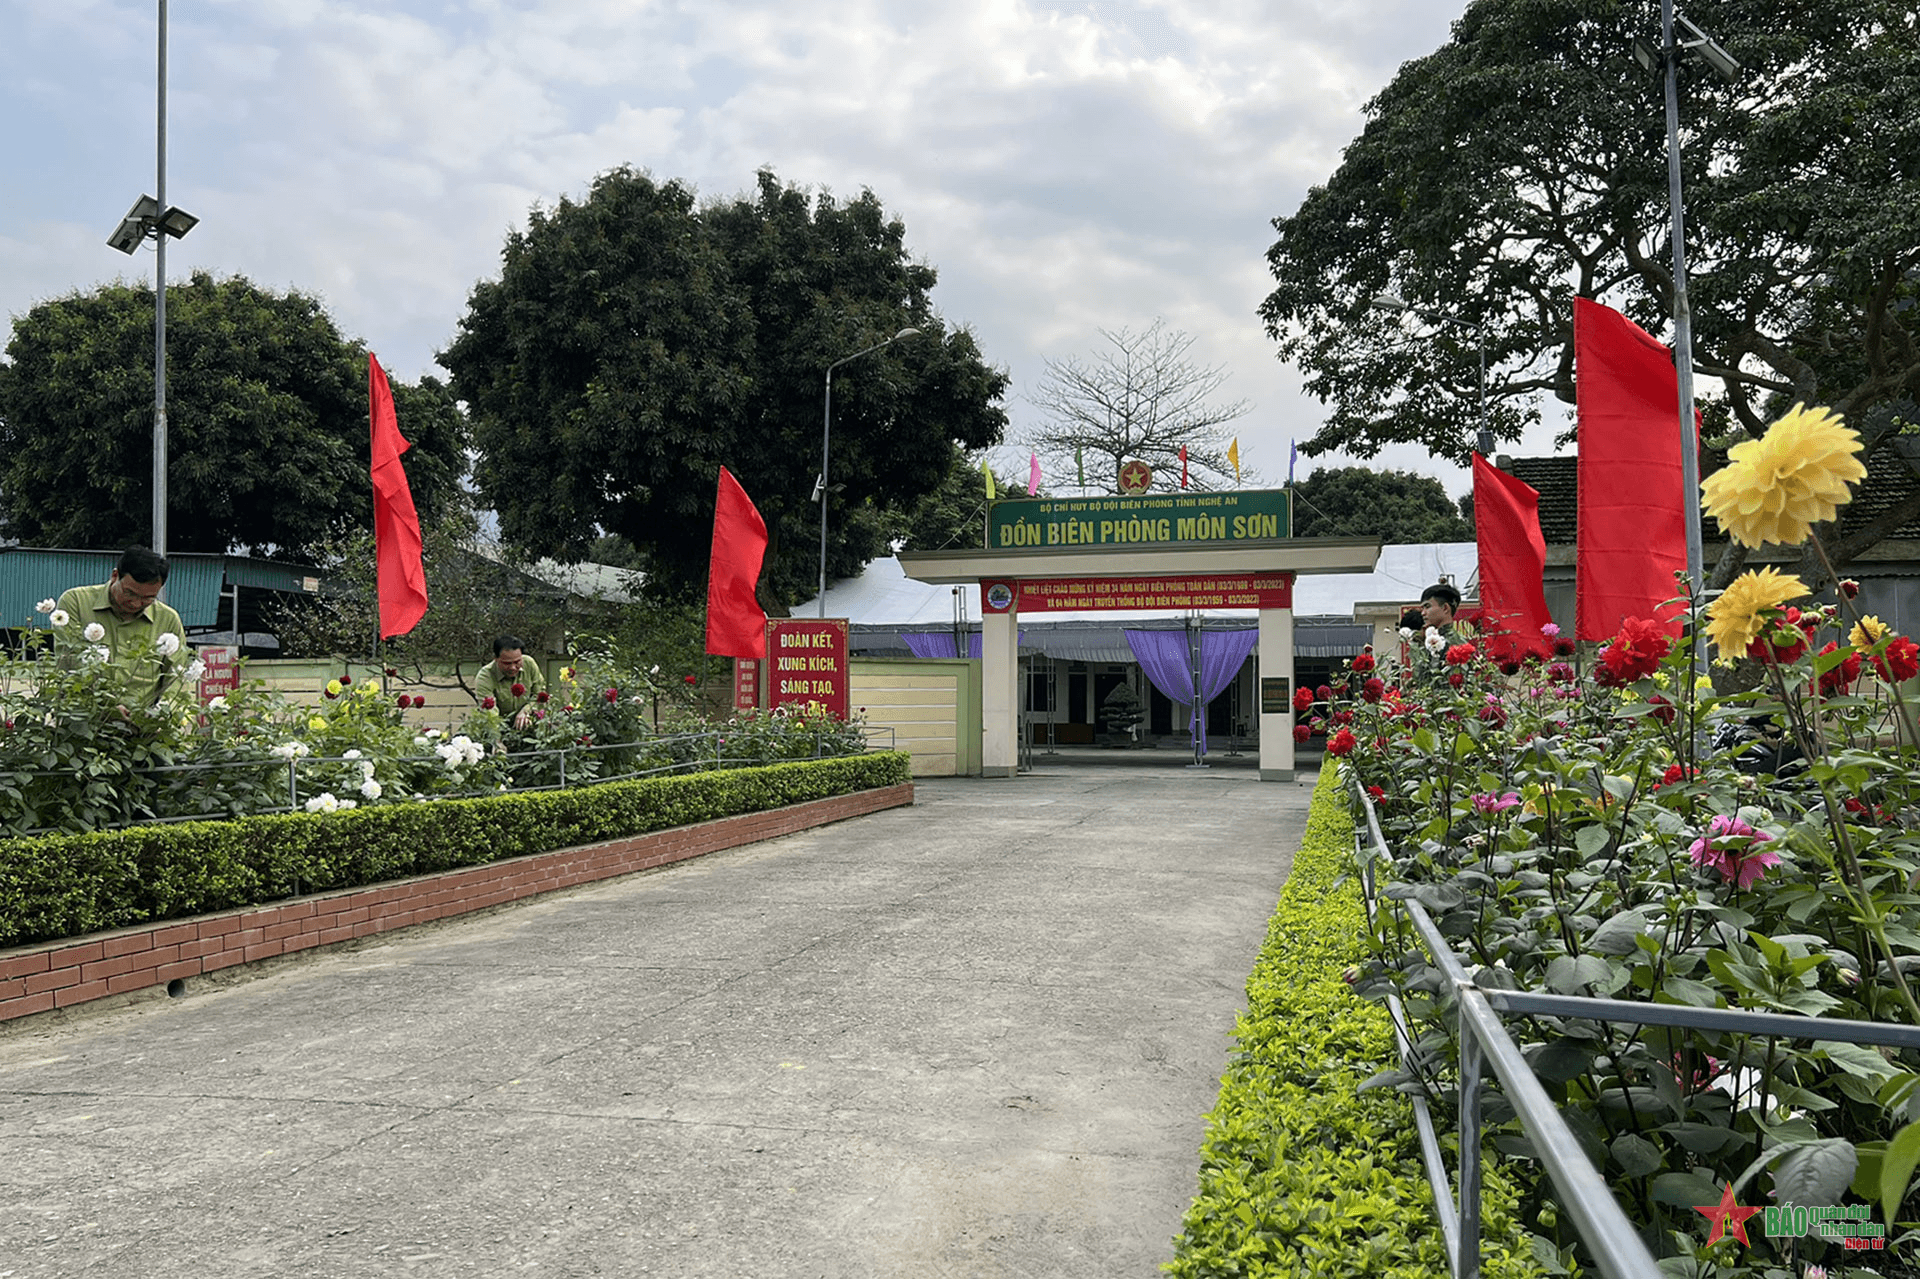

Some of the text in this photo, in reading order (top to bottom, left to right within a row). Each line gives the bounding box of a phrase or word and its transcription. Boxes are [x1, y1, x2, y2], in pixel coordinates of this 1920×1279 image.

[1040, 503, 1052, 514] BỘ
[1070, 502, 1088, 512] HUY
[1089, 501, 1102, 512] BỘ
[1103, 500, 1118, 511] ĐỘI
[1120, 499, 1141, 510] BIÊN
[1143, 498, 1173, 509] PHÒNG
[1176, 496, 1196, 507] TỈNH
[1198, 496, 1222, 507] NGHỆ
[1224, 496, 1238, 505] AN
[1000, 512, 1277, 546] ĐỒN BIÊN PHÒNG MÔN SƠN
[780, 629, 834, 649] ĐOÀN KẾT,
[778, 655, 838, 672] XUNG KÍCH,
[780, 677, 835, 698] SÁNG TẠO,
